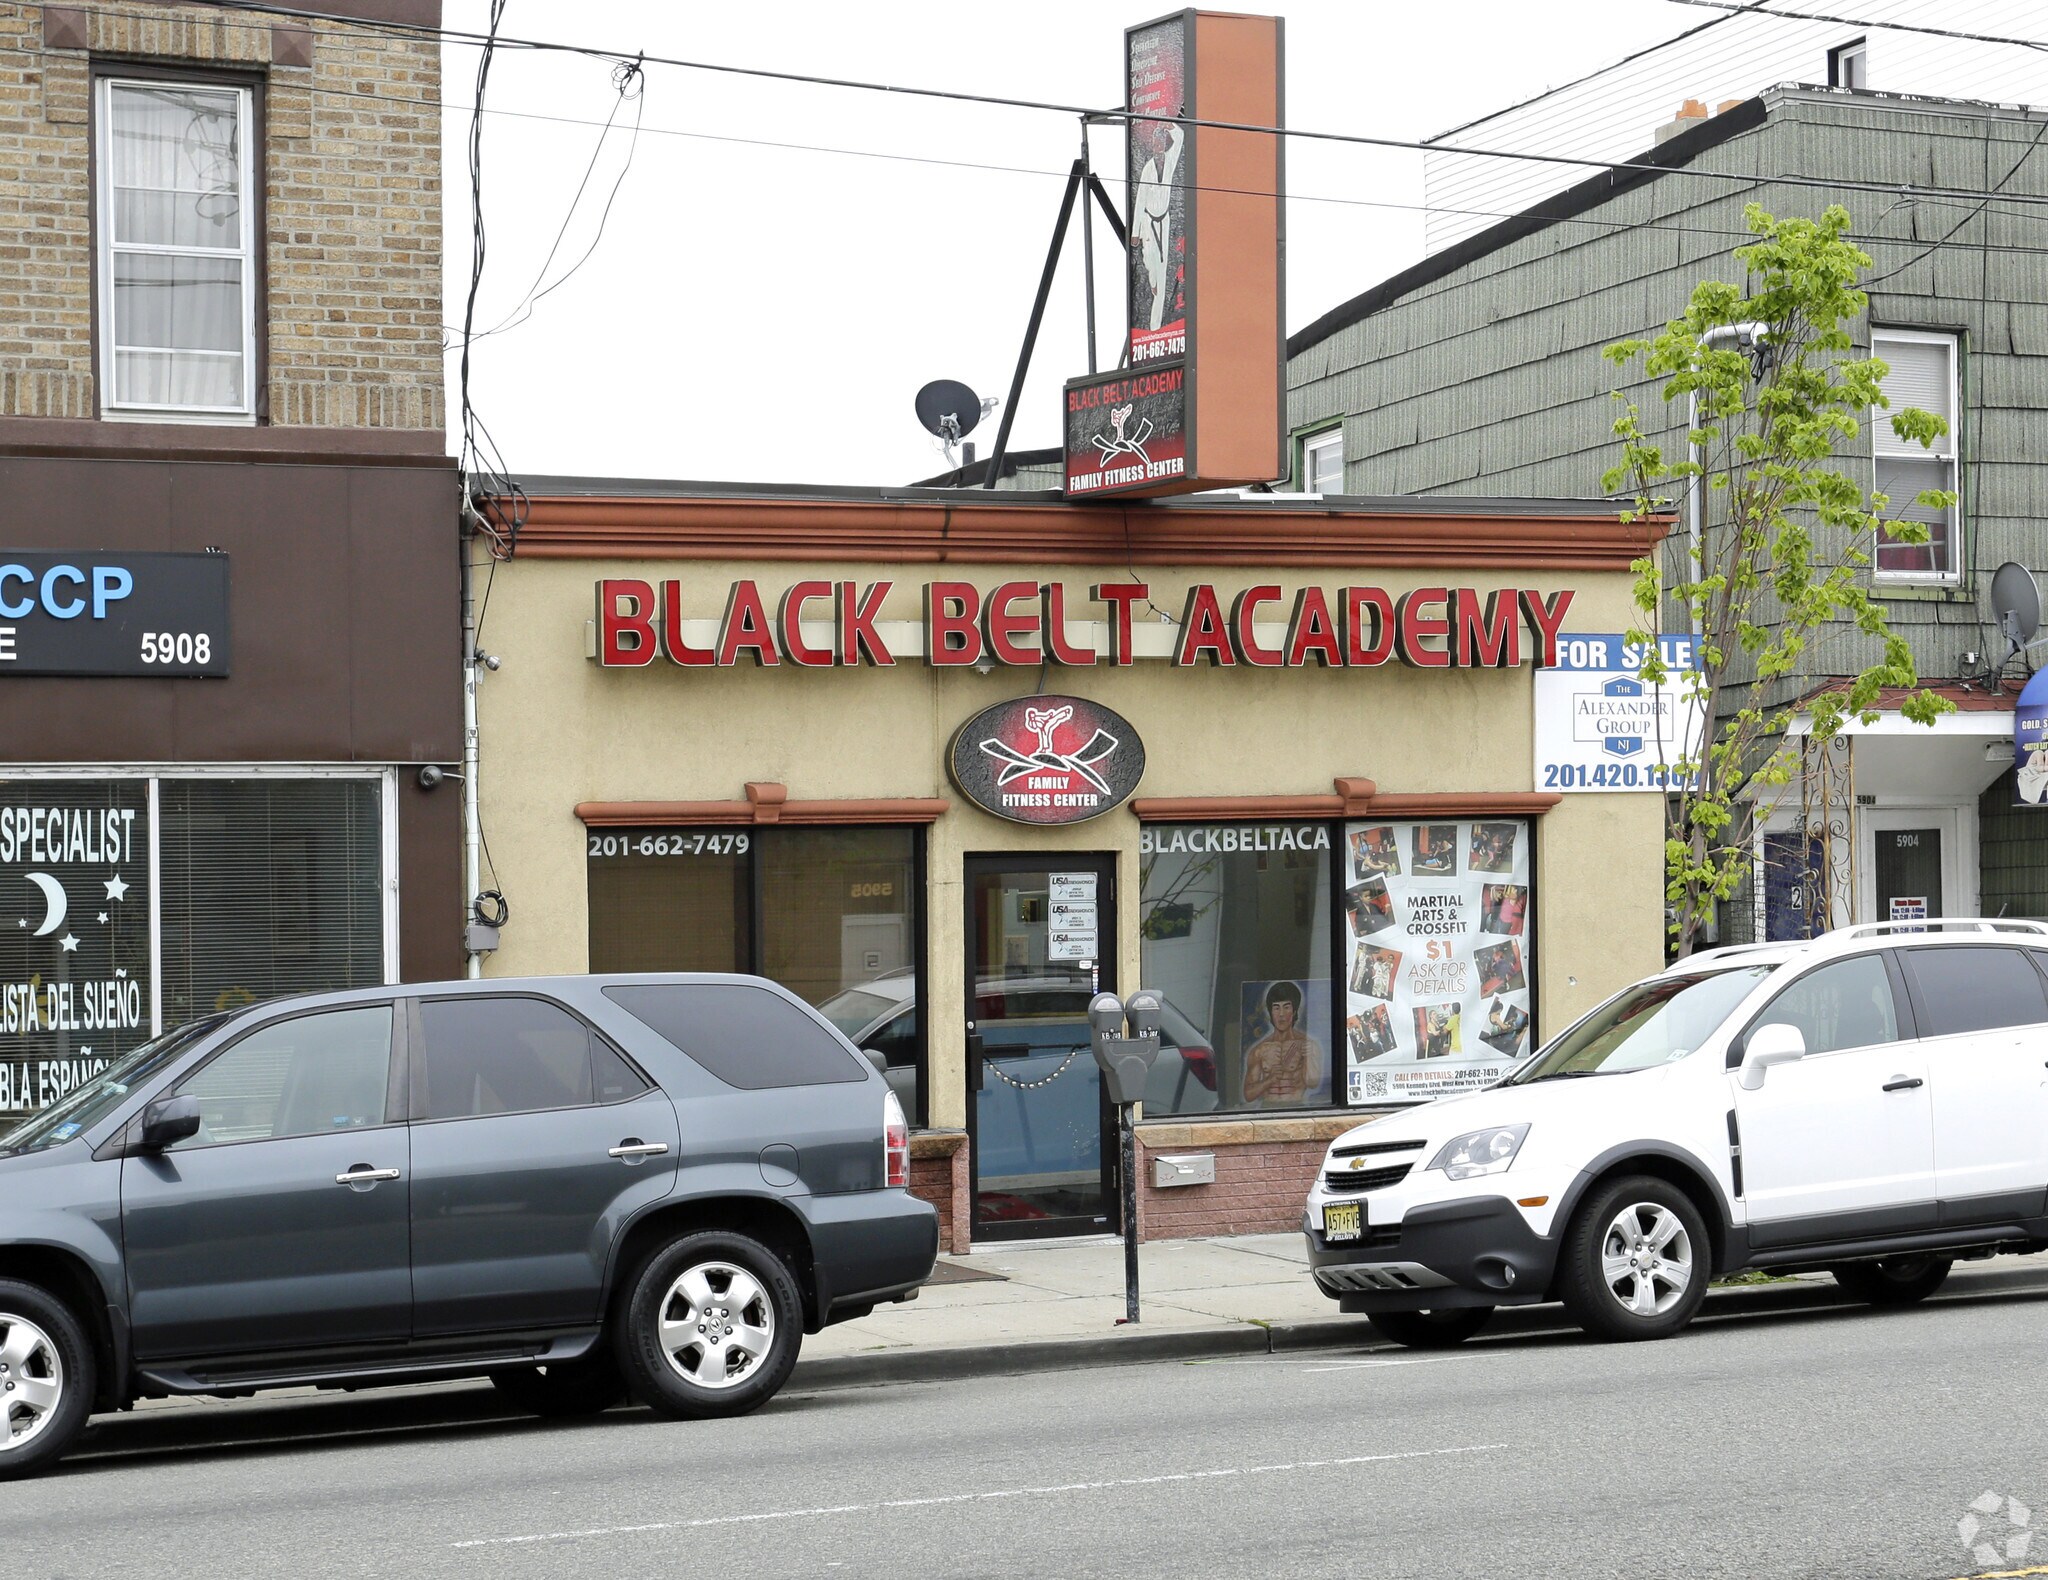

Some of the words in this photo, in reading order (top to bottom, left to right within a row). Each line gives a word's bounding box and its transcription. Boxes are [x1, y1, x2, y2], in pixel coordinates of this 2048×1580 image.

[1132, 336, 1186, 362] 201-662-7479
[1069, 388, 1100, 412] BLACK
[1103, 380, 1131, 404] BELT
[1132, 368, 1184, 400] ACADEMY
[1070, 472, 1102, 492] FAMILY
[1105, 466, 1144, 486] FITNESS
[1147, 457, 1184, 479] CENTER
[0, 564, 133, 619] CCP
[598, 579, 896, 667] BLACK
[925, 580, 1149, 668] BELT
[1176, 583, 1577, 668] ACADEMY
[140, 632, 211, 664] 5908
[1556, 640, 1607, 668] FOR
[1618, 739, 1629, 752] NJ
[1028, 776, 1069, 790] FAMILY
[1545, 763, 1700, 788] 201.420.130
[1002, 793, 1050, 807] FITNESS
[1054, 793, 1098, 807] CENTER
[0, 807, 135, 863] SPECIALIST
[588, 834, 749, 856] 201-662-7479
[1139, 827, 1331, 853] BLACKBELTACA
[1896, 834, 1919, 848] 5904
[1052, 877, 1069, 885] USA
[1407, 895, 1464, 908] MARTIAL
[1792, 887, 1802, 909] 2
[1052, 905, 1069, 913] USA
[1412, 909, 1444, 921] ARTS
[1448, 908, 1457, 920] &
[1052, 934, 1069, 942] USA
[1406, 921, 1467, 935] CROSSFIT
[1426, 939, 1452, 960] $1
[1408, 963, 1437, 978] ASK
[1441, 961, 1467, 976] FOR
[1413, 978, 1466, 994] DETAILS
[47, 983, 79, 1031] DEL
[83, 968, 140, 1029] SUEÑO
[0, 1062, 32, 1110] BLA
[39, 1045, 109, 1109] ESPAÑ
[1394, 1073, 1409, 1082] CALL
[1410, 1072, 1424, 1081] FOR
[1424, 1070, 1454, 1081] DETAILS:
[1455, 1068, 1499, 1079] 201-662-7479
[1406, 1081, 1428, 1090] Kennedy
